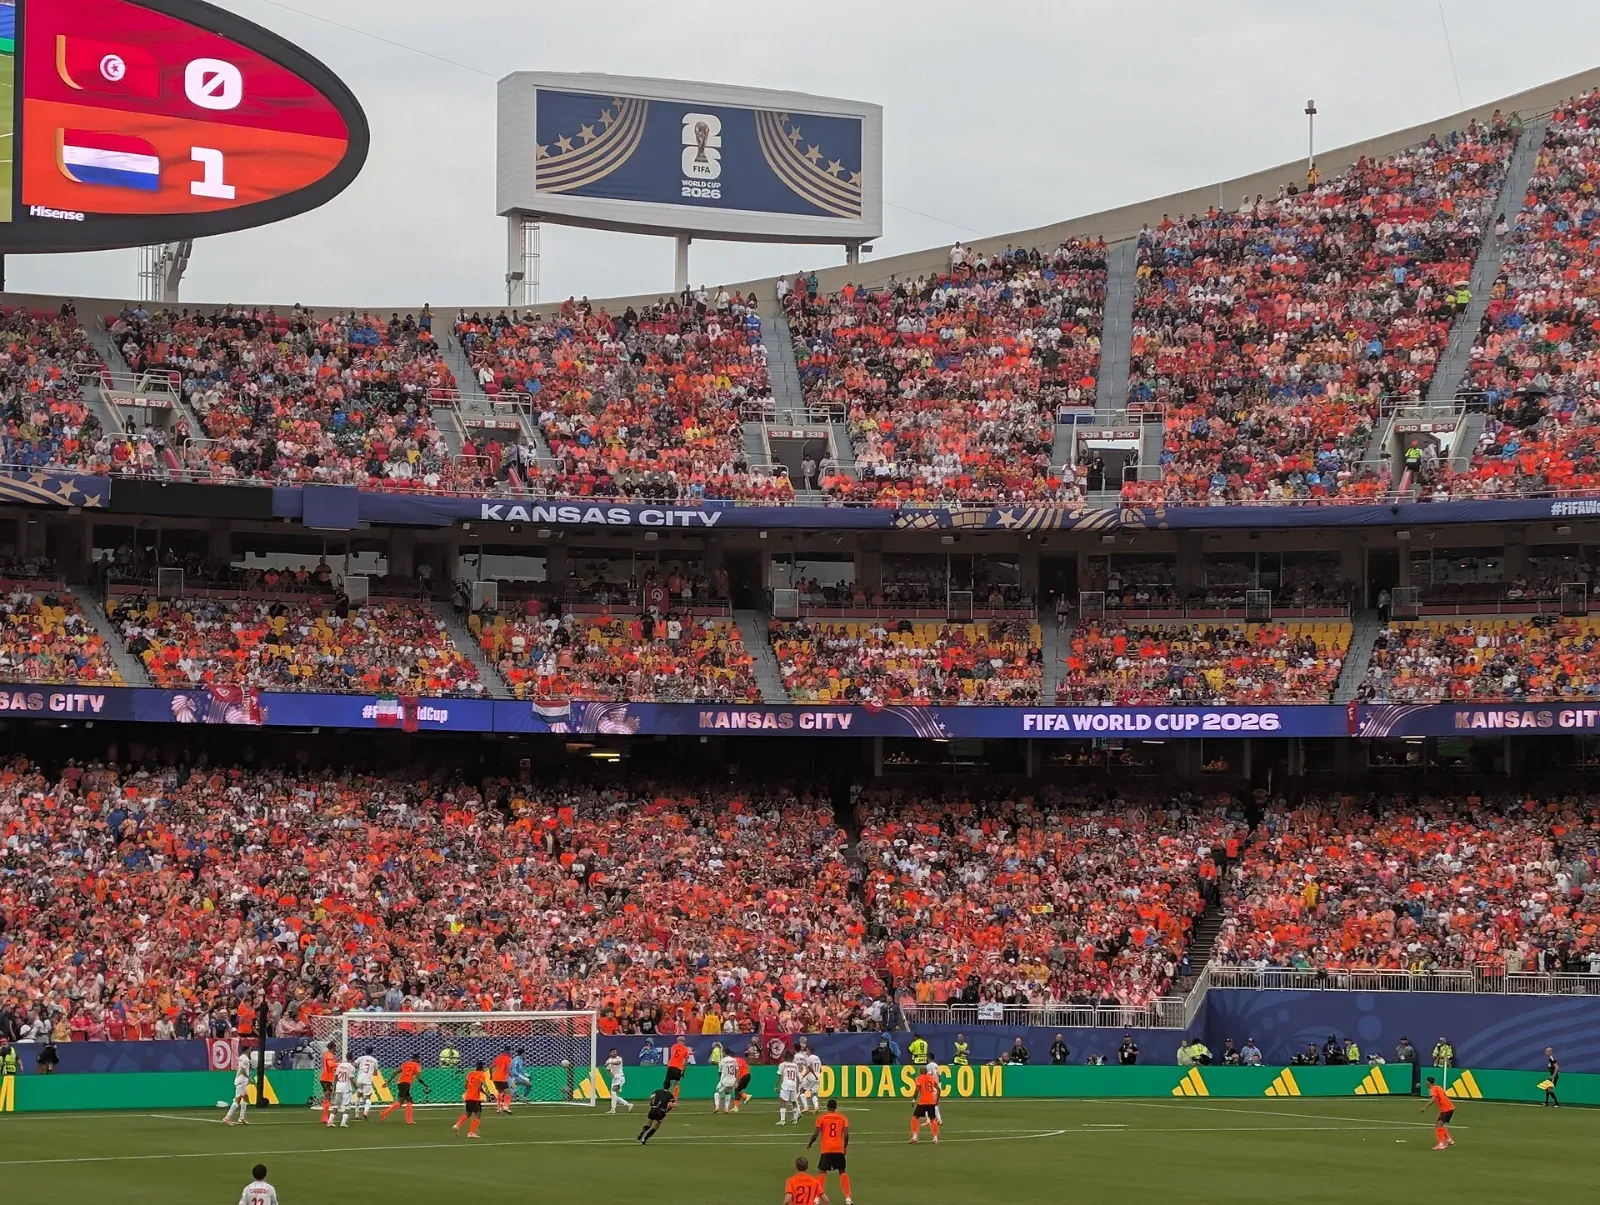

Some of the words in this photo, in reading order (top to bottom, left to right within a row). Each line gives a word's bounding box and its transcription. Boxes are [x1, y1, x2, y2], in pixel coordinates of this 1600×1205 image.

[184, 57, 243, 110] 0
[190, 146, 236, 200] 1
[692, 166, 711, 174] FIFA
[681, 180, 707, 188] WORLD
[707, 181, 722, 189] CUP
[681, 186, 722, 199] 2026
[29, 205, 85, 222] Hisense
[149, 400, 168, 408] 337
[480, 503, 632, 526] KANSAS
[638, 509, 723, 527] CITY
[49, 693, 105, 713] CITY
[699, 711, 794, 729] KANSAS
[799, 712, 853, 729] CITY
[1023, 714, 1070, 731] FIFA
[1071, 714, 1152, 731] WORLD
[1154, 714, 1199, 731] CUP
[1202, 713, 1280, 731] 2026
[1455, 710, 1553, 729] KANSAS
[1559, 709, 1600, 728] CIT
[829, 1122, 837, 1138] 8
[795, 1185, 812, 1205] 21
